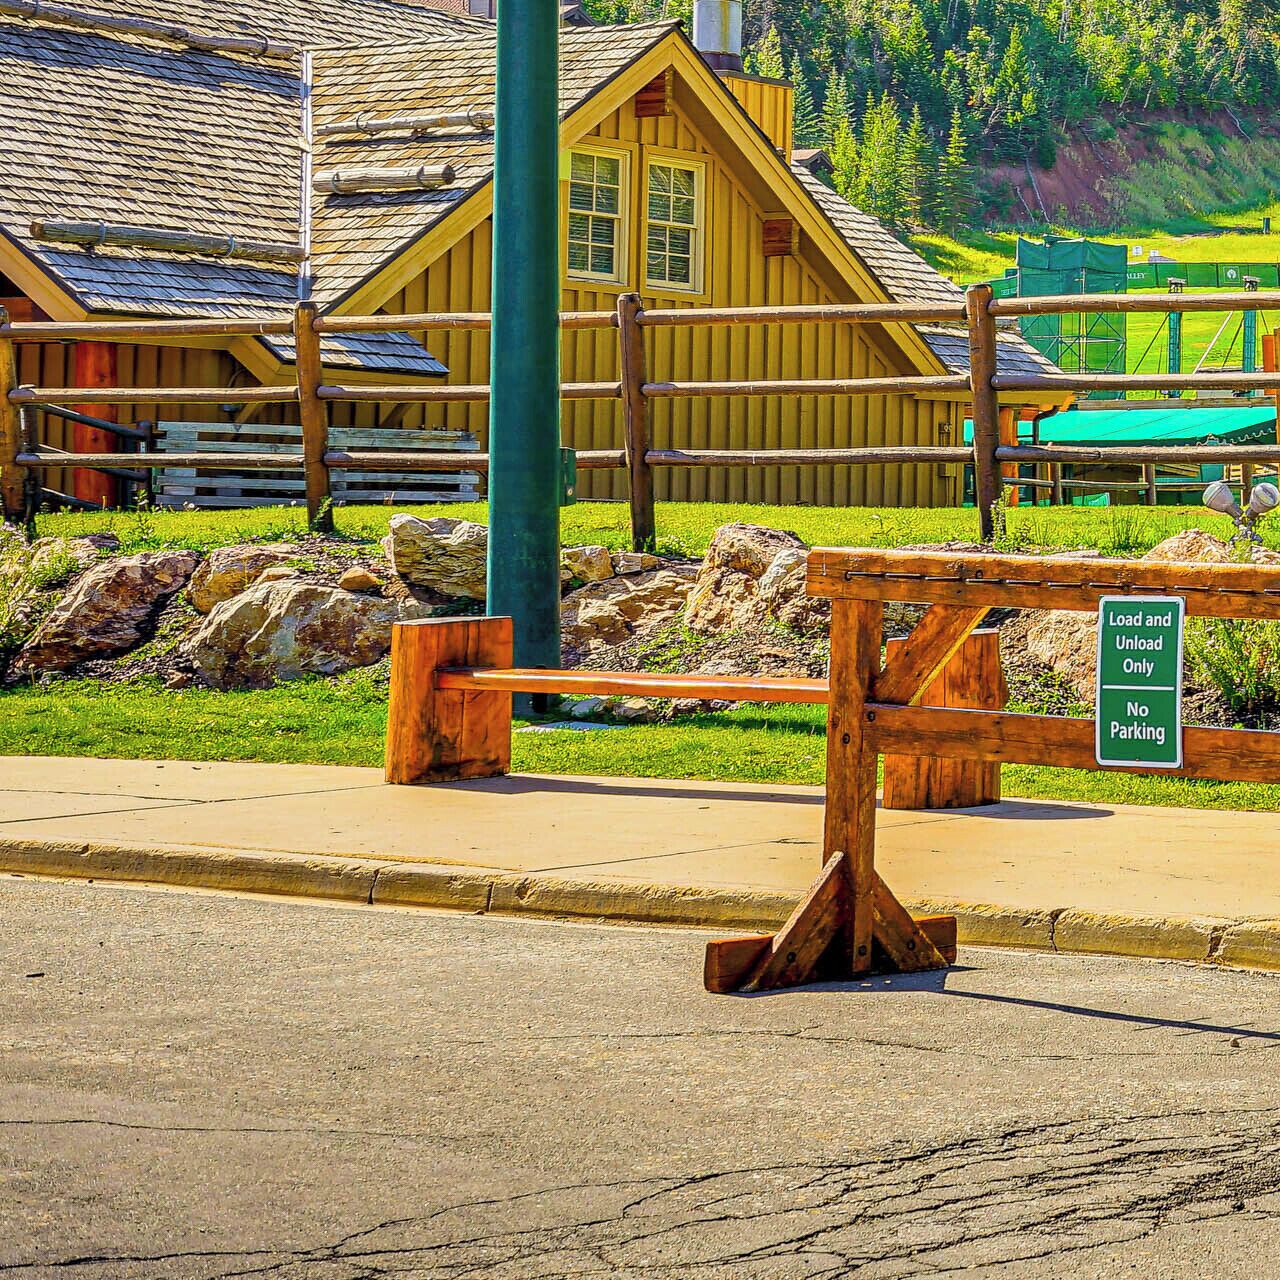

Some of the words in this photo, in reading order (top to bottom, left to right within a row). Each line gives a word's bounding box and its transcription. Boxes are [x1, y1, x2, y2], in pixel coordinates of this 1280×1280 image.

[1109, 611, 1142, 626] Load
[1145, 612, 1172, 627] and
[1115, 635, 1163, 651] Unload
[1123, 658, 1154, 677] Only
[1127, 702, 1149, 717] No
[1110, 721, 1165, 745] Parking
